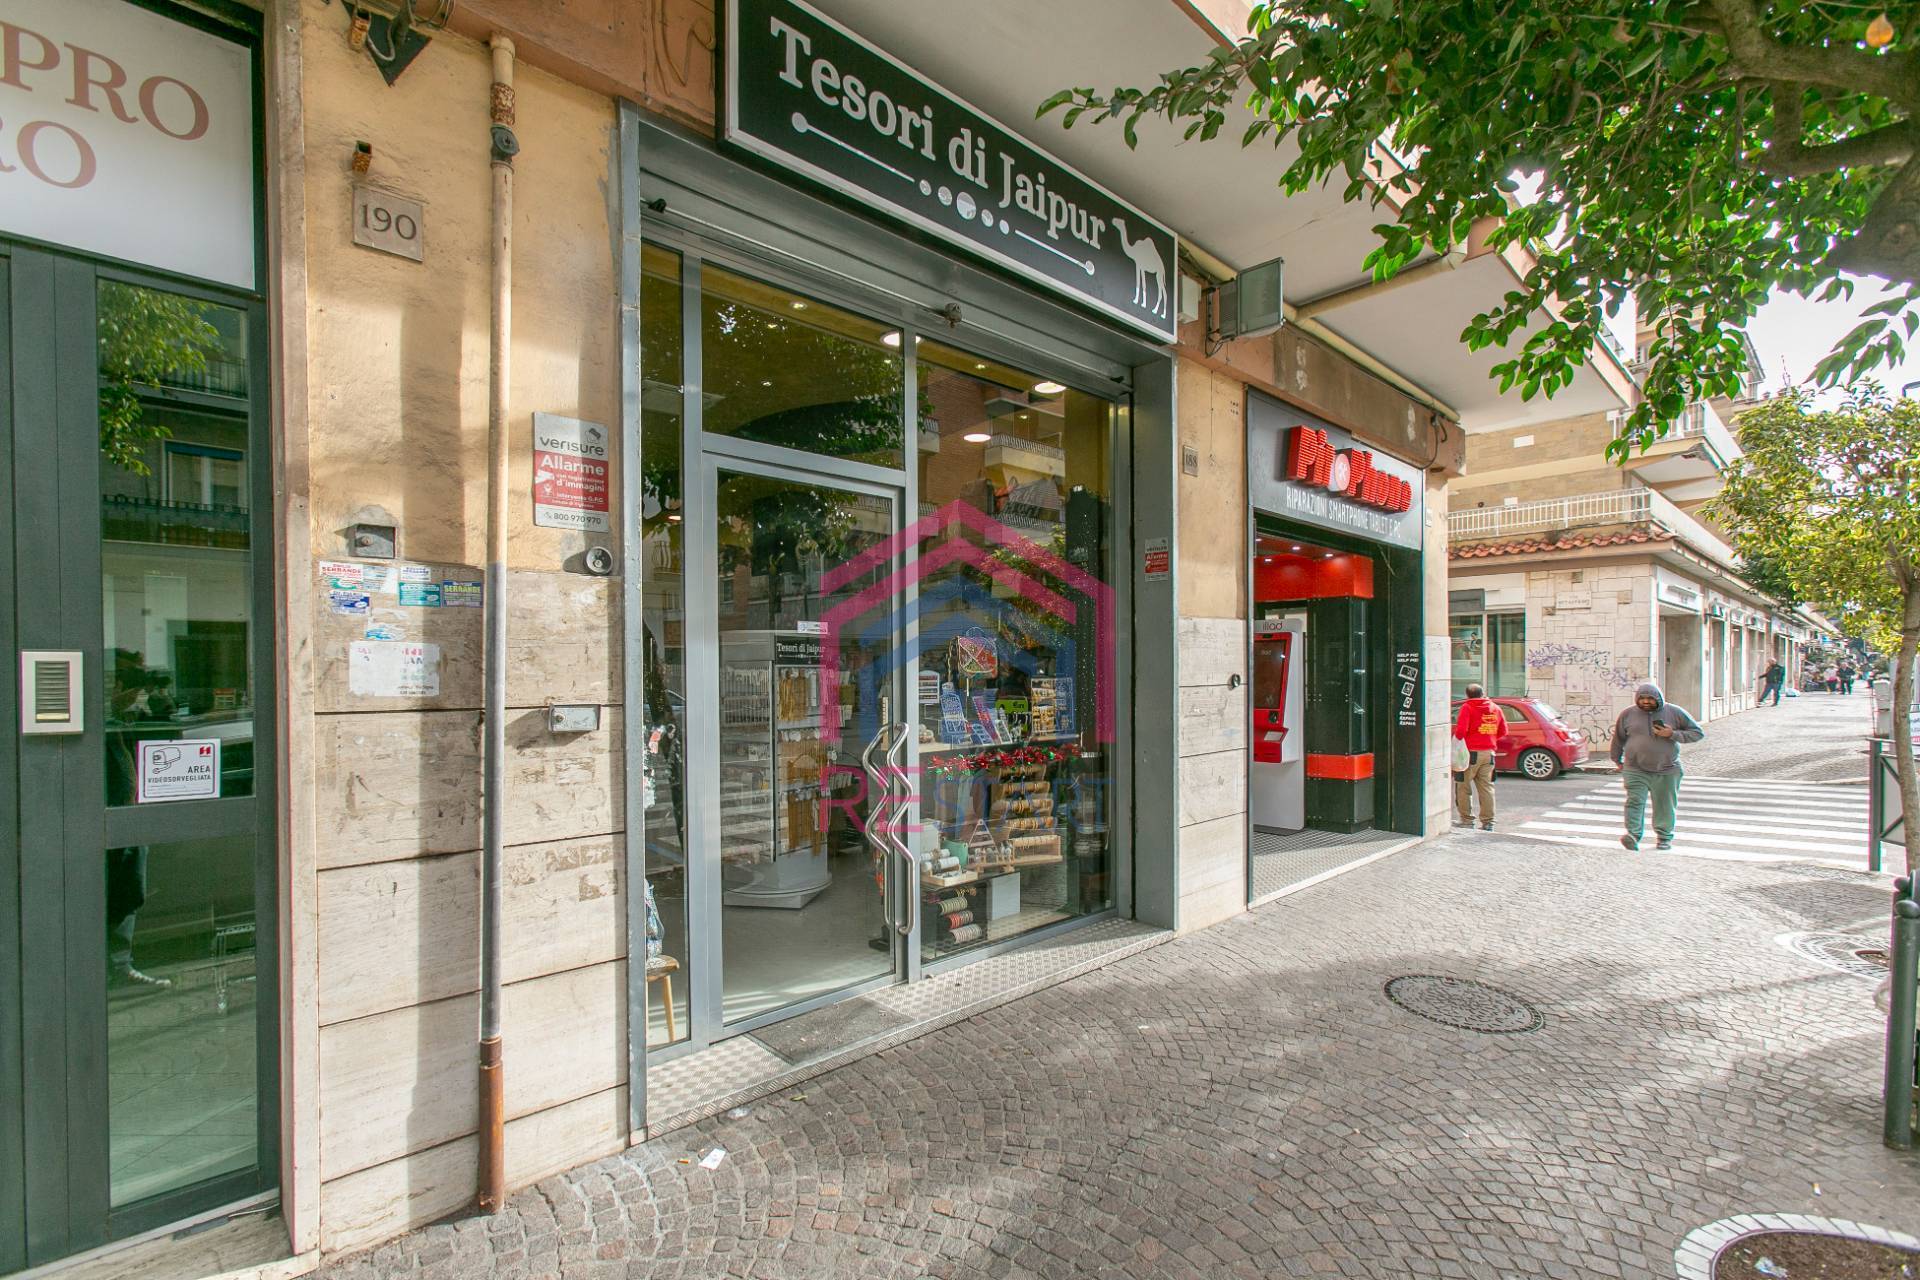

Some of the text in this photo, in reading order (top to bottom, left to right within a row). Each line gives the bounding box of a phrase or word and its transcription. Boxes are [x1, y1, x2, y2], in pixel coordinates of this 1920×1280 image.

[770, 16, 1106, 250] Tesori di Jaipur
[0, 116, 97, 189] O
[360, 202, 417, 241] 190
[540, 436, 605, 457] verisure
[541, 454, 605, 476] Allarme
[556, 480, 605, 493] d'immagini
[553, 512, 570, 521] 800
[571, 514, 586, 523] 970
[586, 516, 602, 525] 970
[1286, 486, 1328, 518] RIPARAZIONI
[1328, 500, 1369, 530] SMARTPHONE
[1262, 621, 1283, 631] iliad
[147, 774, 212, 784] VIDEOSORVEGLIATA
[187, 765, 211, 774] AREA
